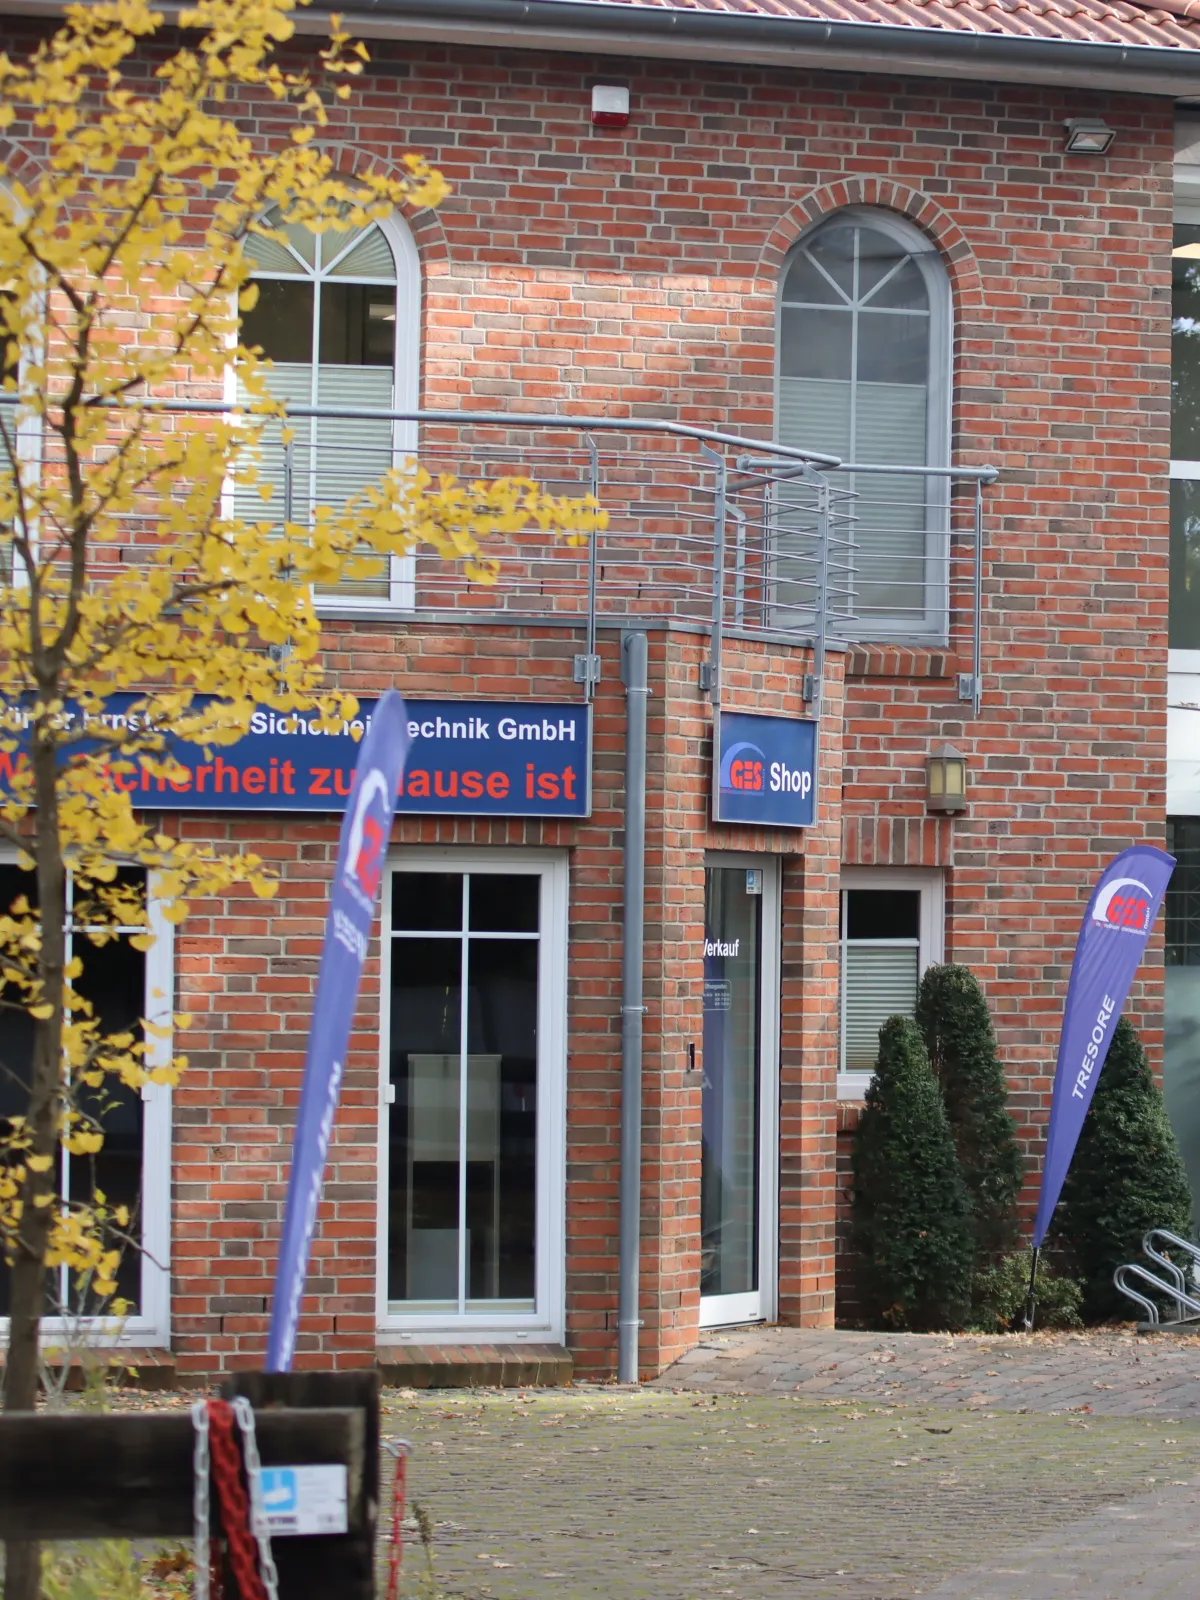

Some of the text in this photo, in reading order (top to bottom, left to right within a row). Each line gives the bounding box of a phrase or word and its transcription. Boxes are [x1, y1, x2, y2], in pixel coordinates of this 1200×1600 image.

[497, 718, 576, 741] GmbH
[525, 763, 576, 800] ist
[730, 759, 811, 800] GES Shop
[1107, 894, 1148, 929] GES
[1072, 993, 1116, 1101] TRESORE
